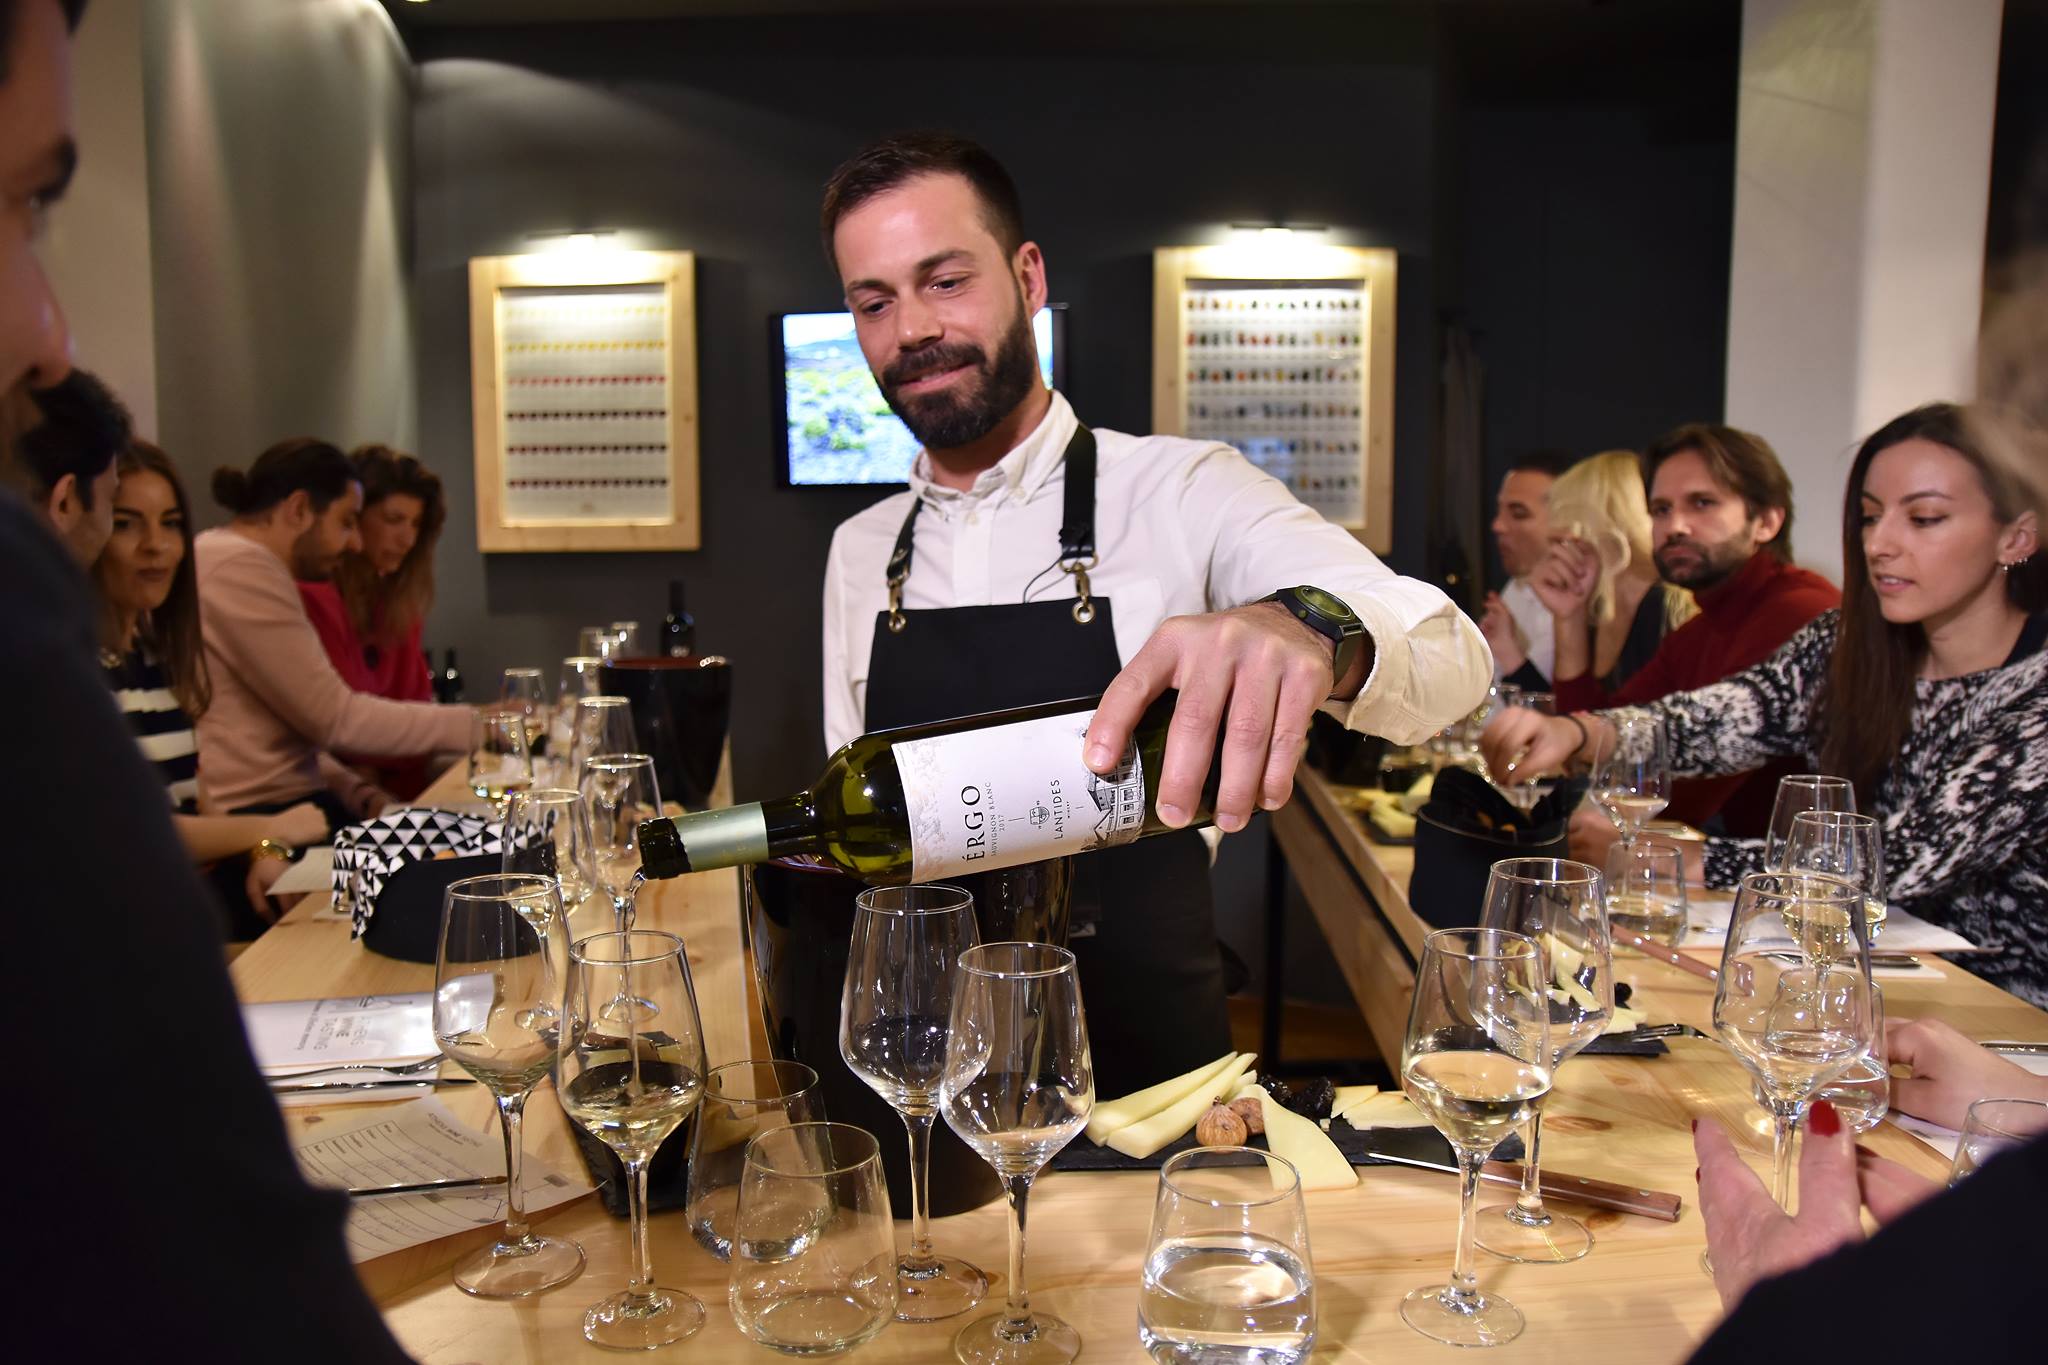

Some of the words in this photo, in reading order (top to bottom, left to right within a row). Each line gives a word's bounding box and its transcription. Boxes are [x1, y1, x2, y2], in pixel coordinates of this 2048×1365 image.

[961, 785, 985, 863] ÉRGO
[985, 782, 995, 810] BLANC
[1050, 779, 1064, 839] LANTIDES
